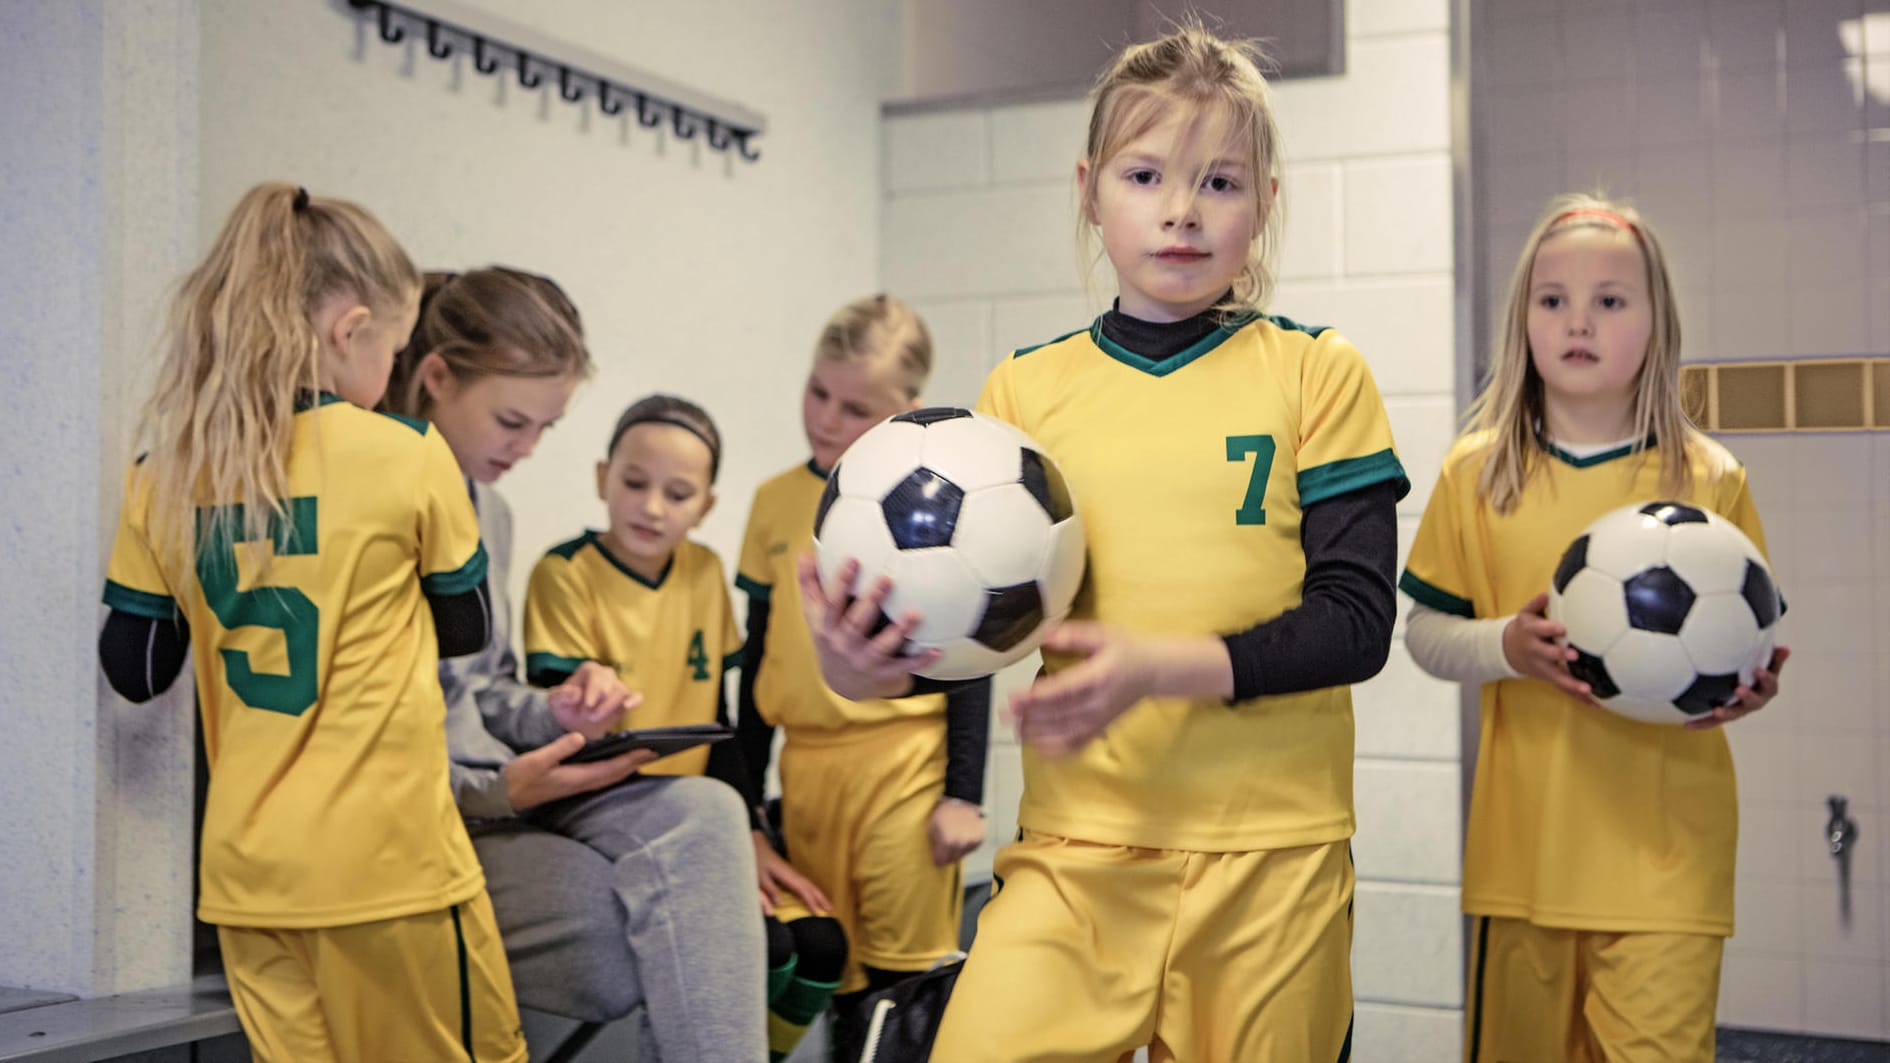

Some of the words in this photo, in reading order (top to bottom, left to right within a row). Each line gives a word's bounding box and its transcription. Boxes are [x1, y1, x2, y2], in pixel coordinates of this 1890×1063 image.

[1226, 434, 1276, 525] 7
[195, 496, 319, 717] 5
[687, 629, 710, 681] 4
